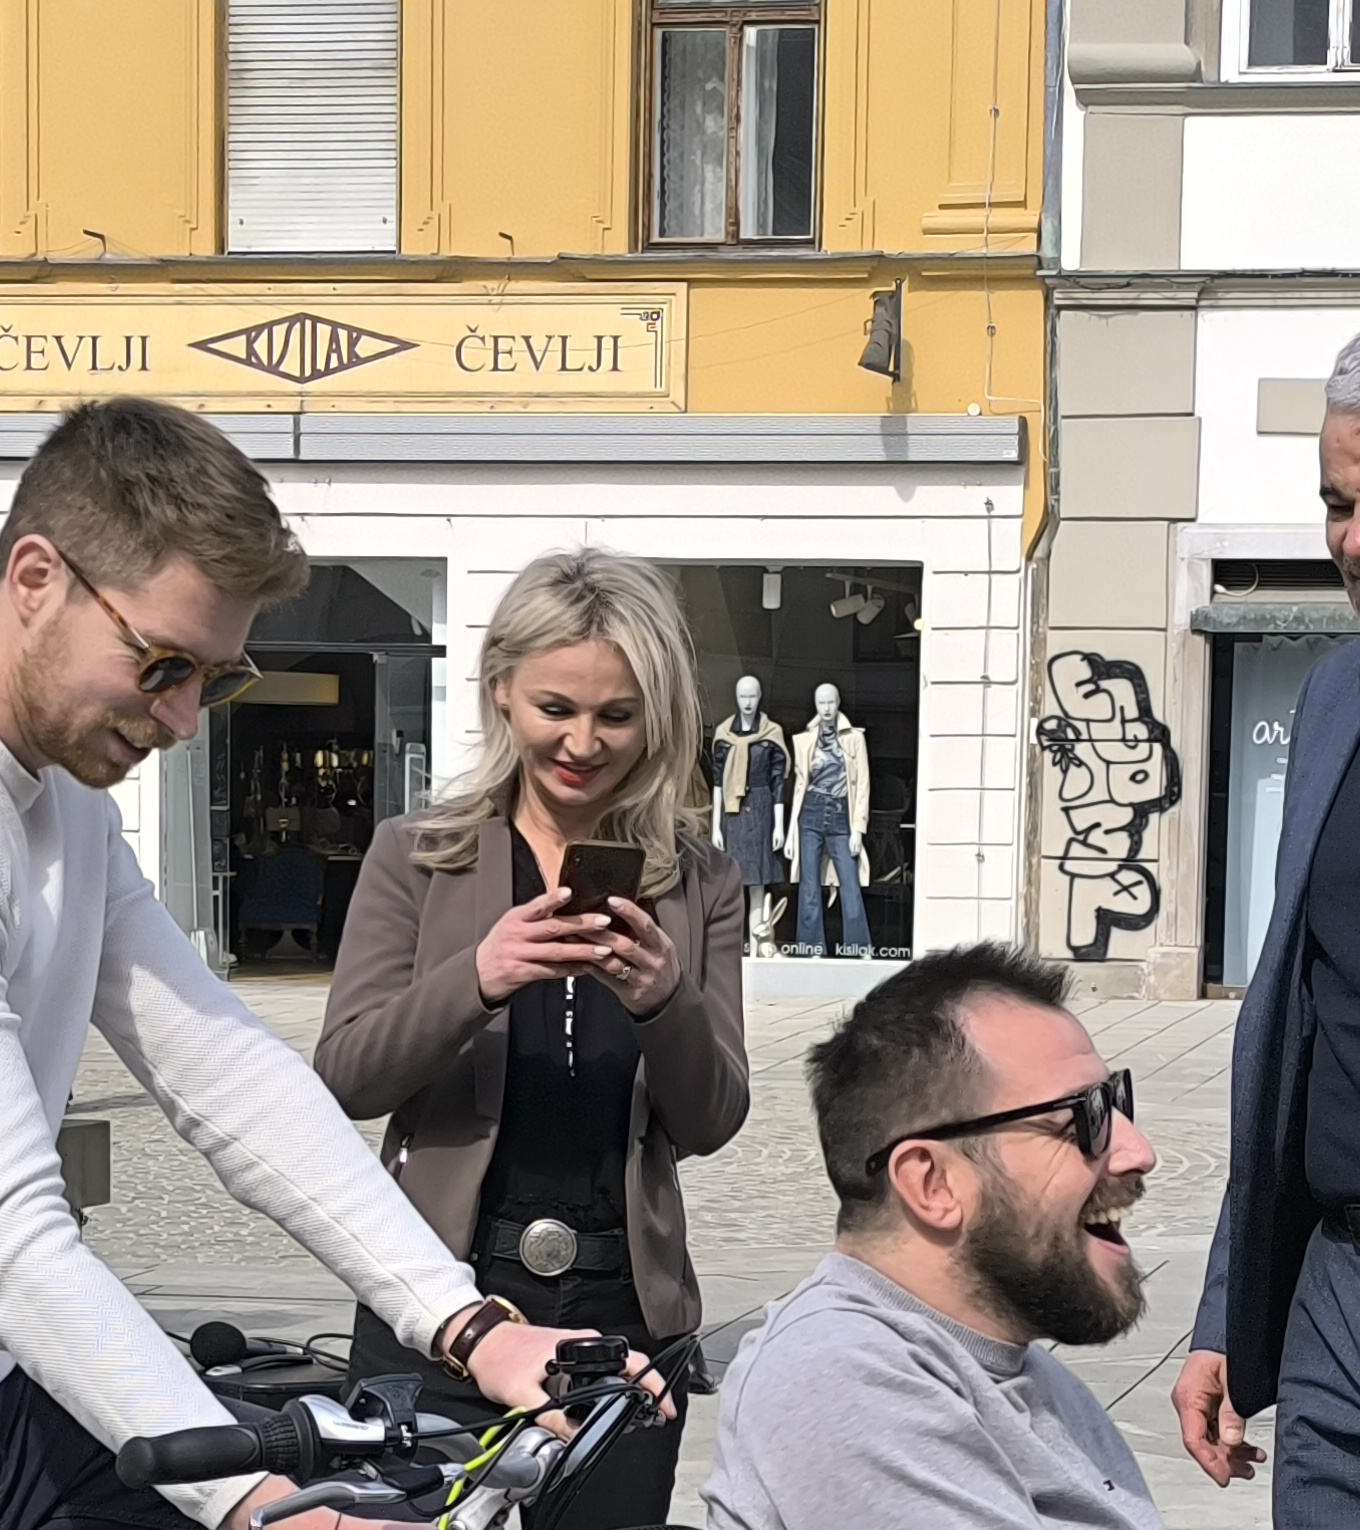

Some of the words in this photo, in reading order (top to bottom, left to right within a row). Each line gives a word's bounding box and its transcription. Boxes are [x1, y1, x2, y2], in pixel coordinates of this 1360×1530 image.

[455, 324, 623, 373] ČEVLJI
[781, 942, 823, 955] online
[835, 943, 911, 958] kisilak.com
